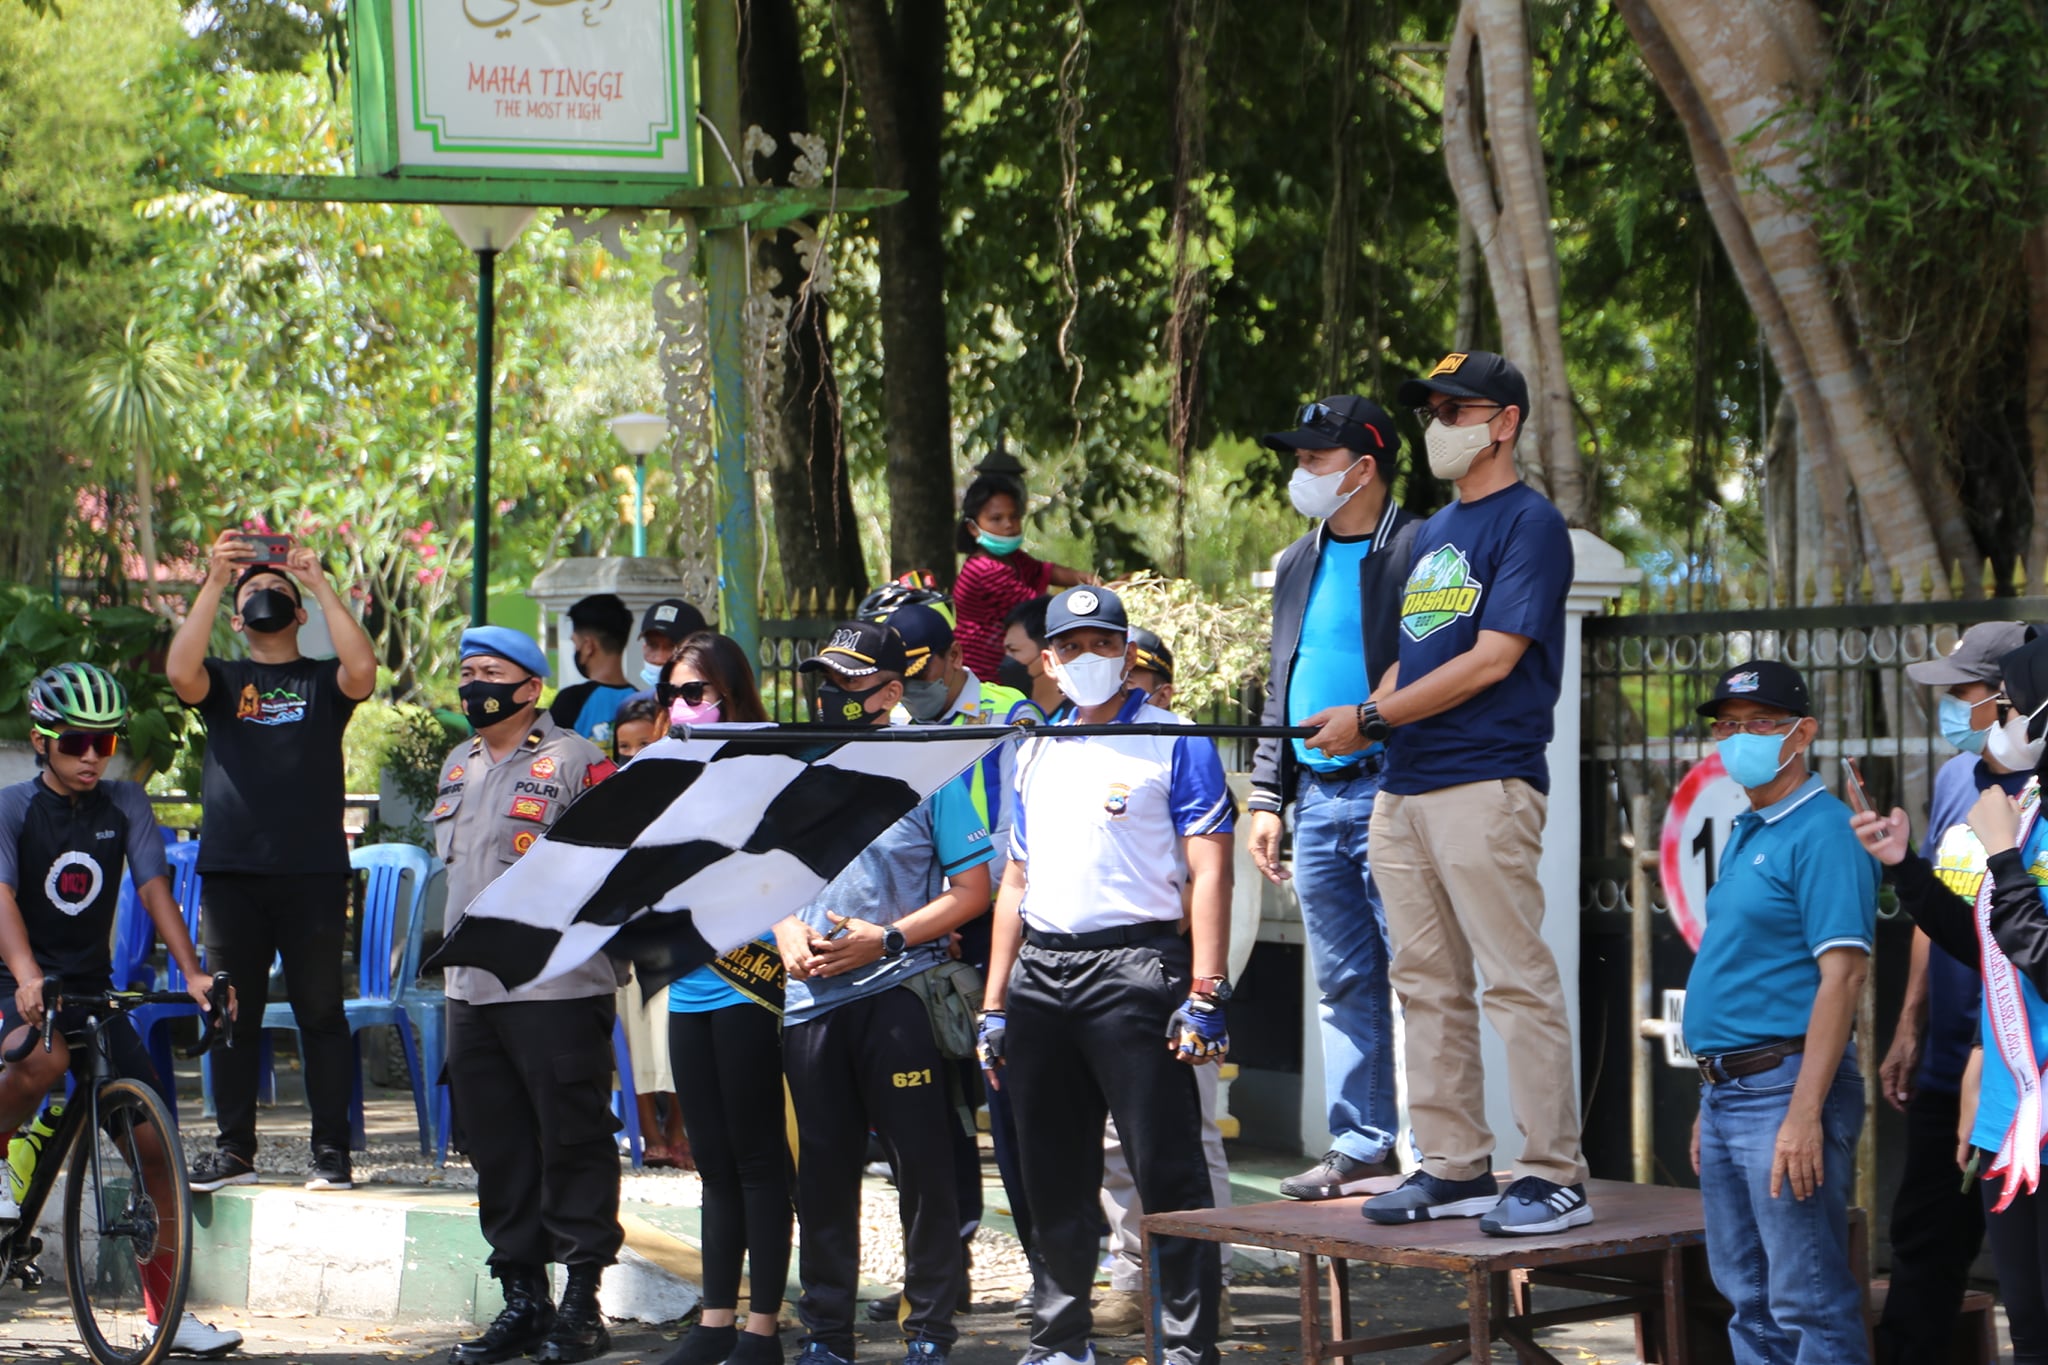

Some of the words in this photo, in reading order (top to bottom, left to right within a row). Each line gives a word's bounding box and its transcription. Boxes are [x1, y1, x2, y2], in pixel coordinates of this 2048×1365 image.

[468, 61, 531, 95] MAHA
[539, 69, 624, 100] TINGGI
[494, 100, 521, 118] THE
[527, 101, 562, 120] MOST
[567, 103, 602, 121] HIGH
[514, 781, 560, 799] POLRI
[1692, 816, 1735, 896] 1
[892, 1068, 931, 1088] 621
